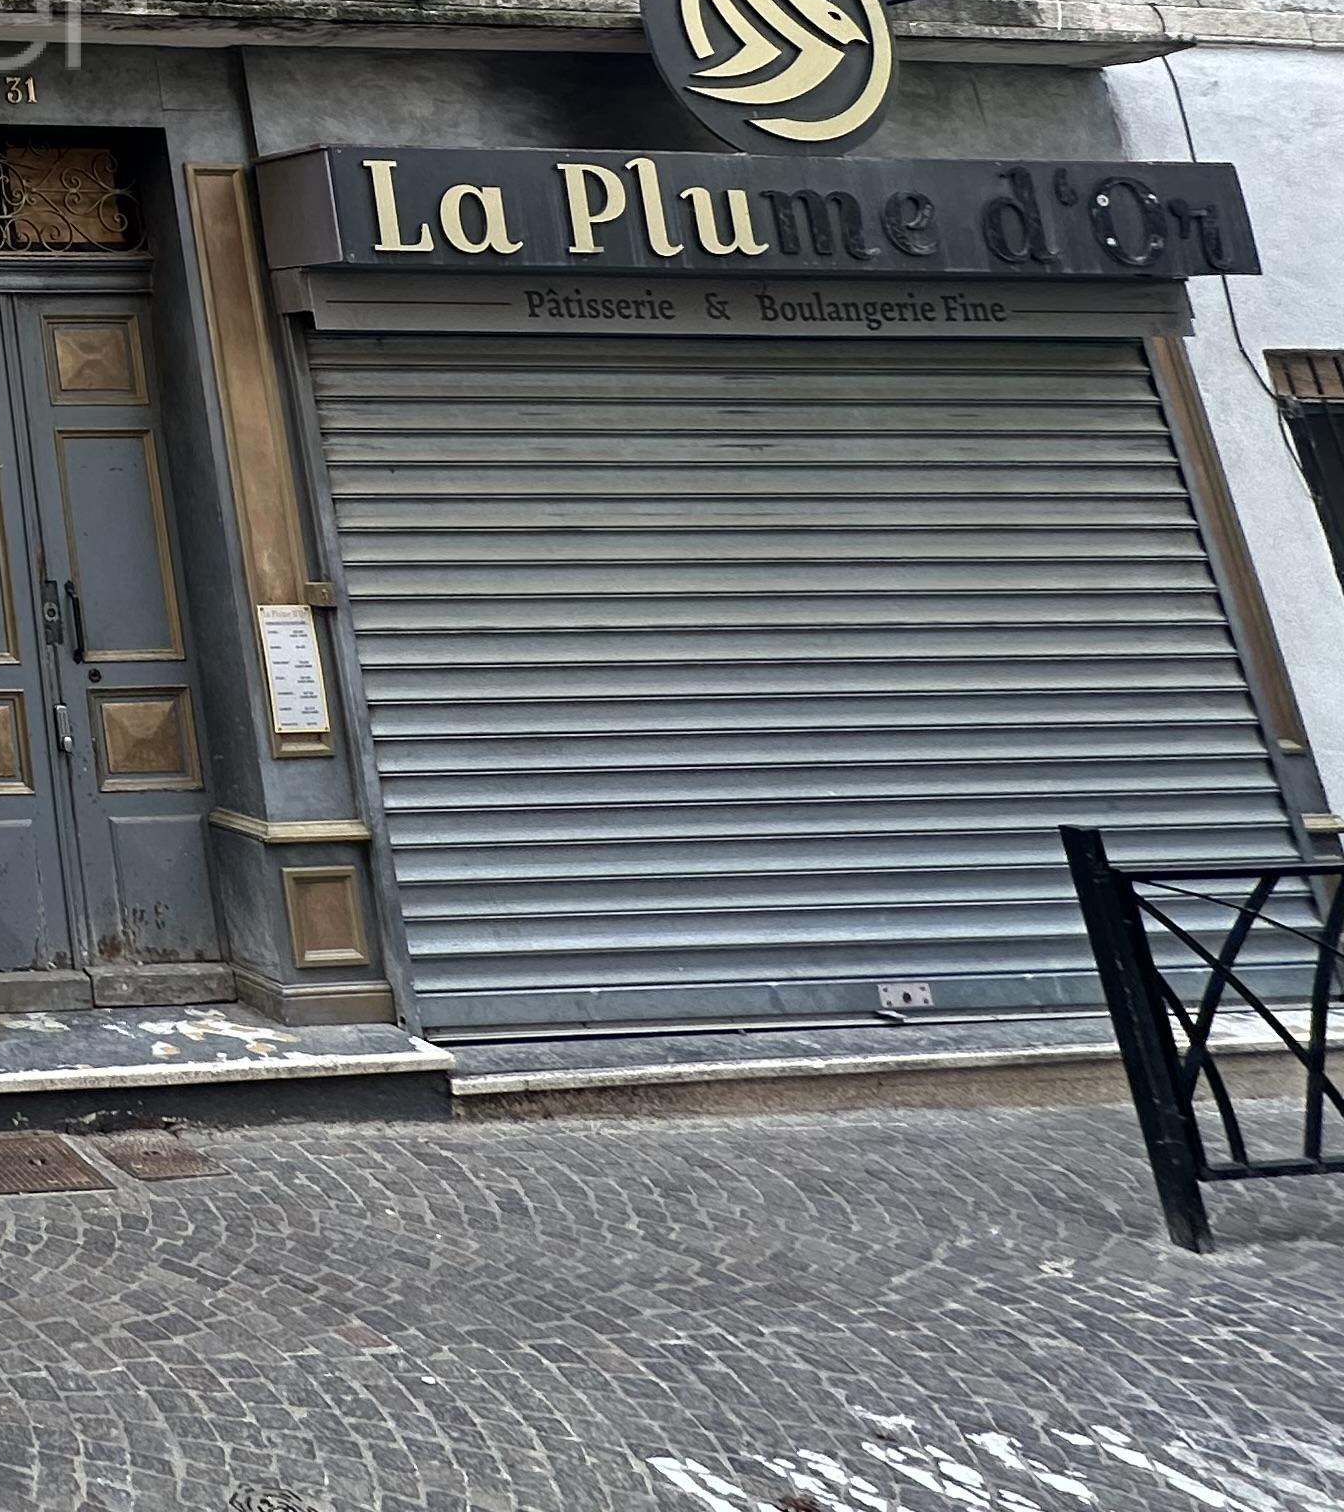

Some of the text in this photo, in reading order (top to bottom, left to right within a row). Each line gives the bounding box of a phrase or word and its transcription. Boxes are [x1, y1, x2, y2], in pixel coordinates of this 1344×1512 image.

[5, 76, 38, 104] 31
[362, 157, 1235, 272] La Plume d'Or
[525, 288, 1008, 330] Pâtisserie & Boulangerie Fine
